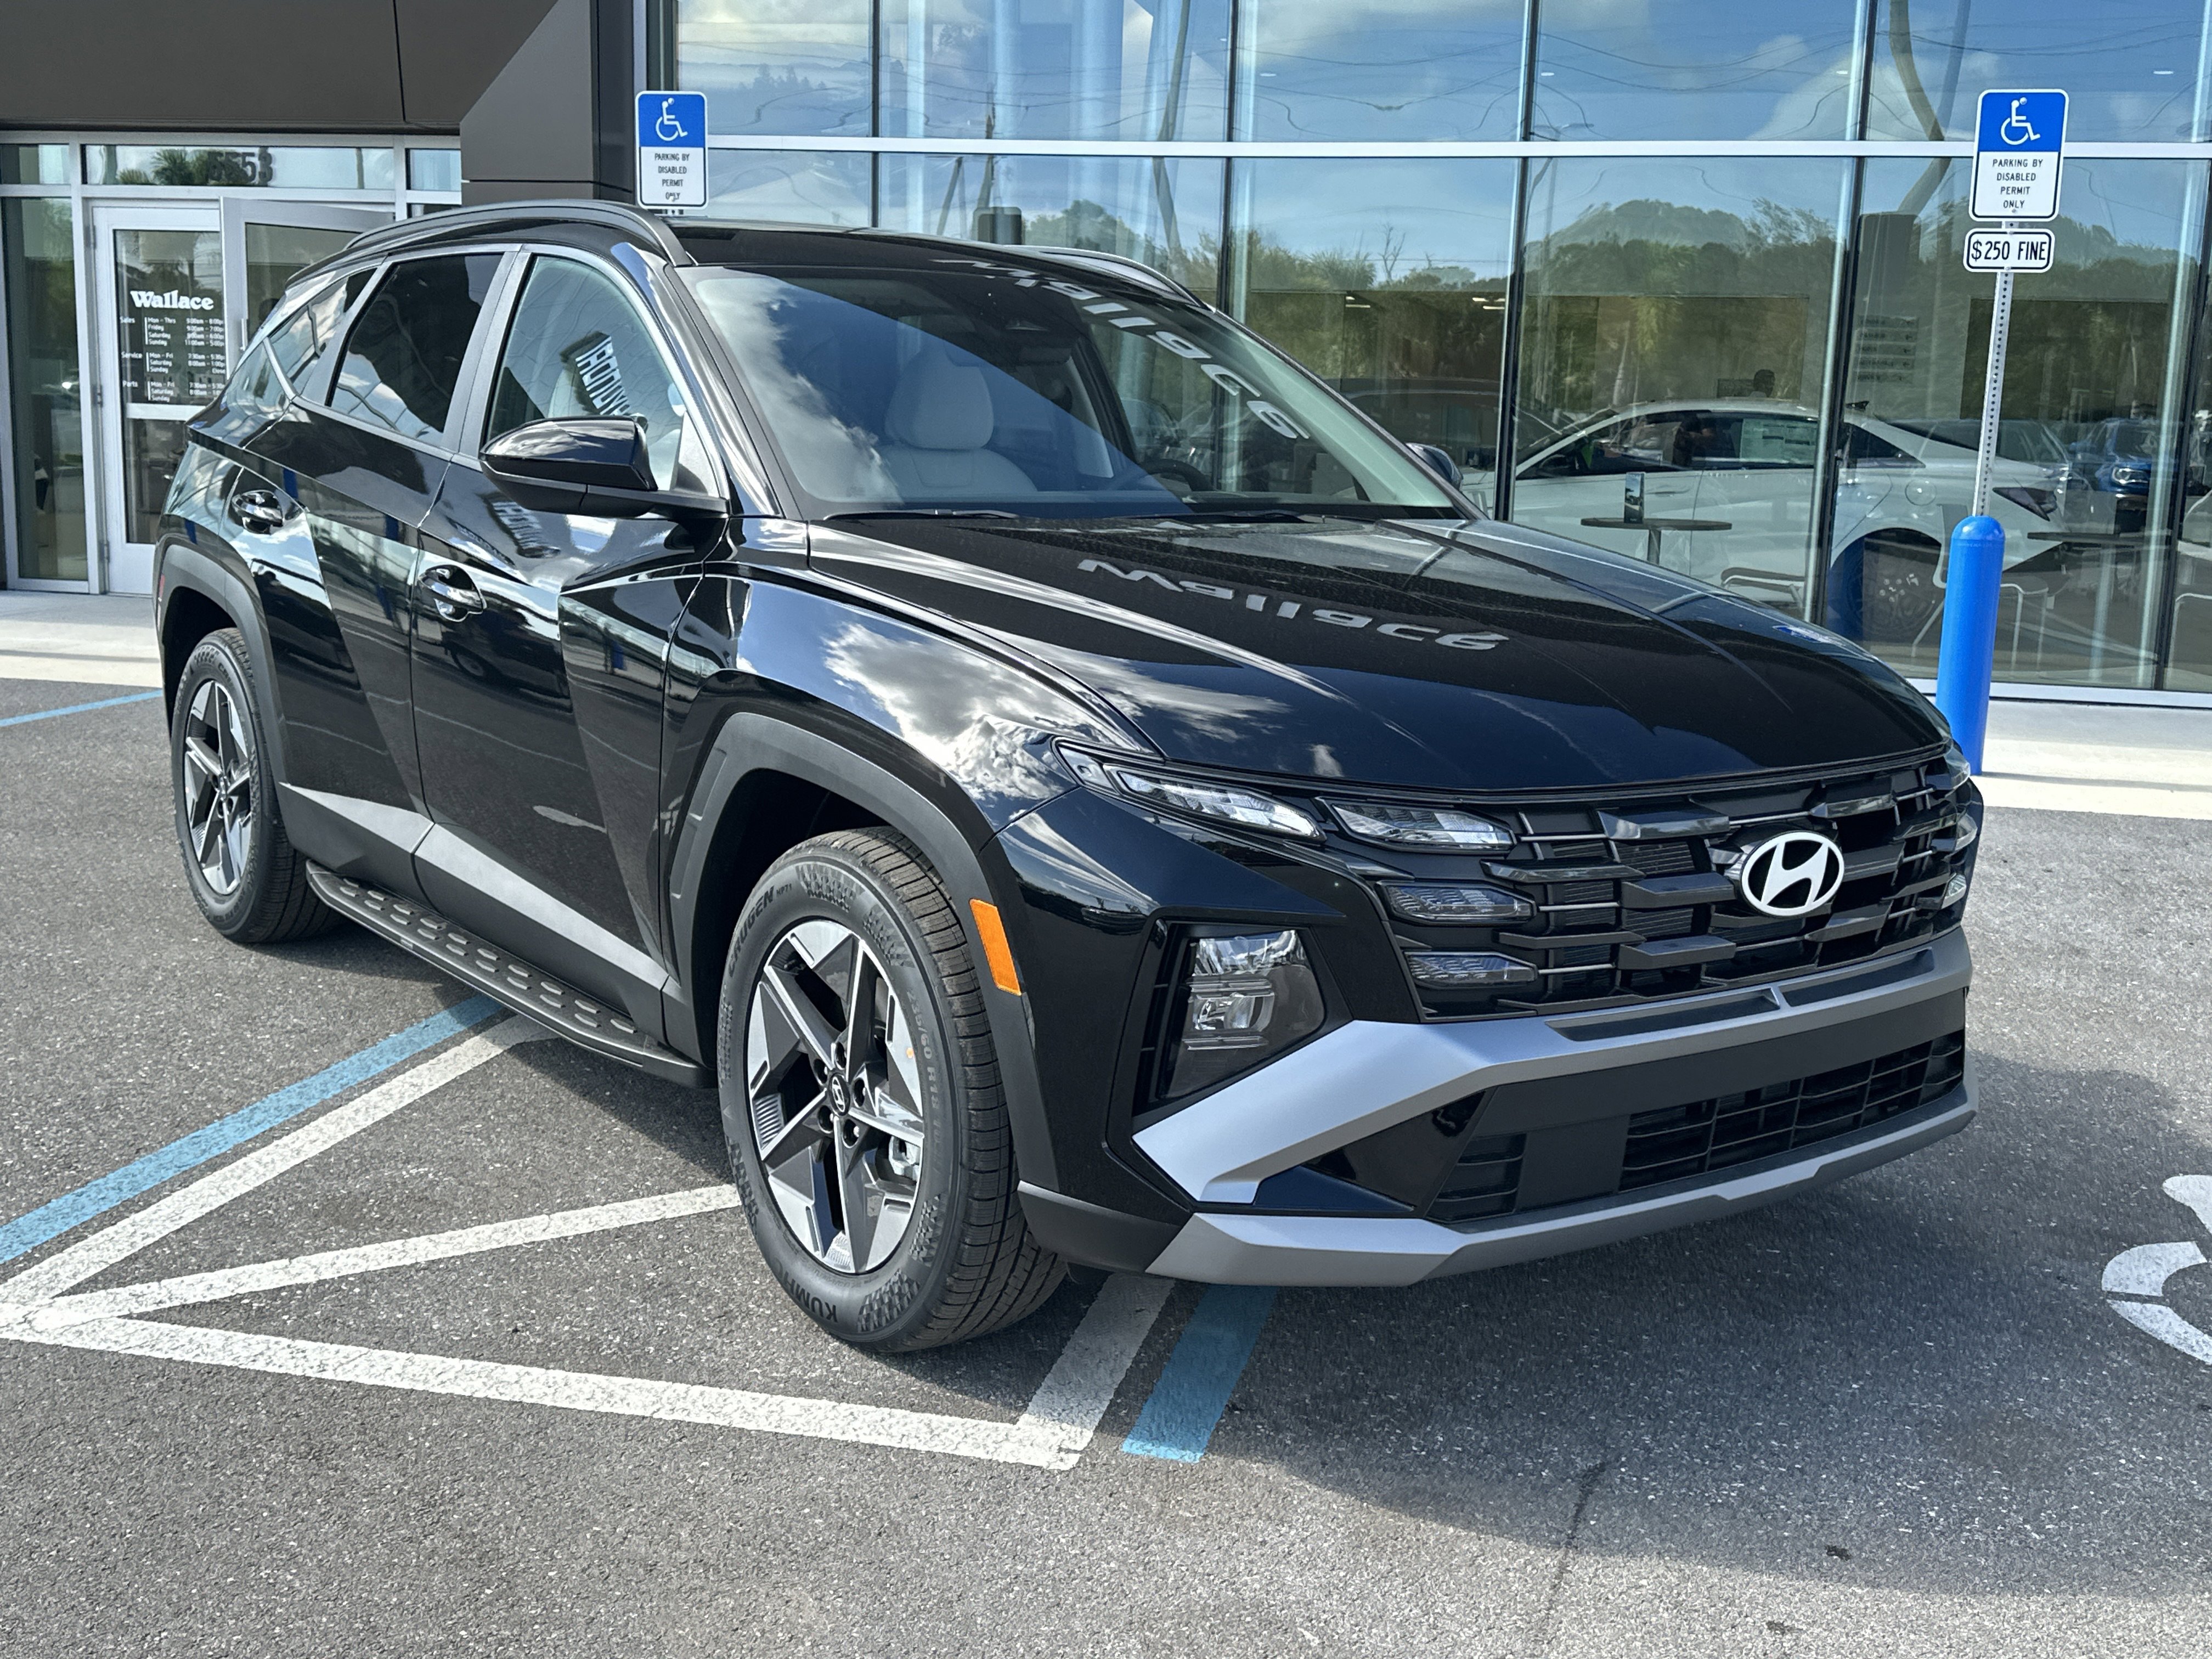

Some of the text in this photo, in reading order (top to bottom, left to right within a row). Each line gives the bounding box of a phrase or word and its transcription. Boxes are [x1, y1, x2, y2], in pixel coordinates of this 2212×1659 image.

[654, 153, 690, 161] PARKING BY
[1993, 159, 2043, 167] PARKING BY
[1996, 172, 2036, 181] DISABLED
[2000, 186, 2030, 195] PERMIT
[2003, 200, 2025, 208] ONLY
[1971, 239, 2047, 262] $250 FINE
[130, 290, 214, 310] Wallace
[728, 885, 775, 978] CRUGEN
